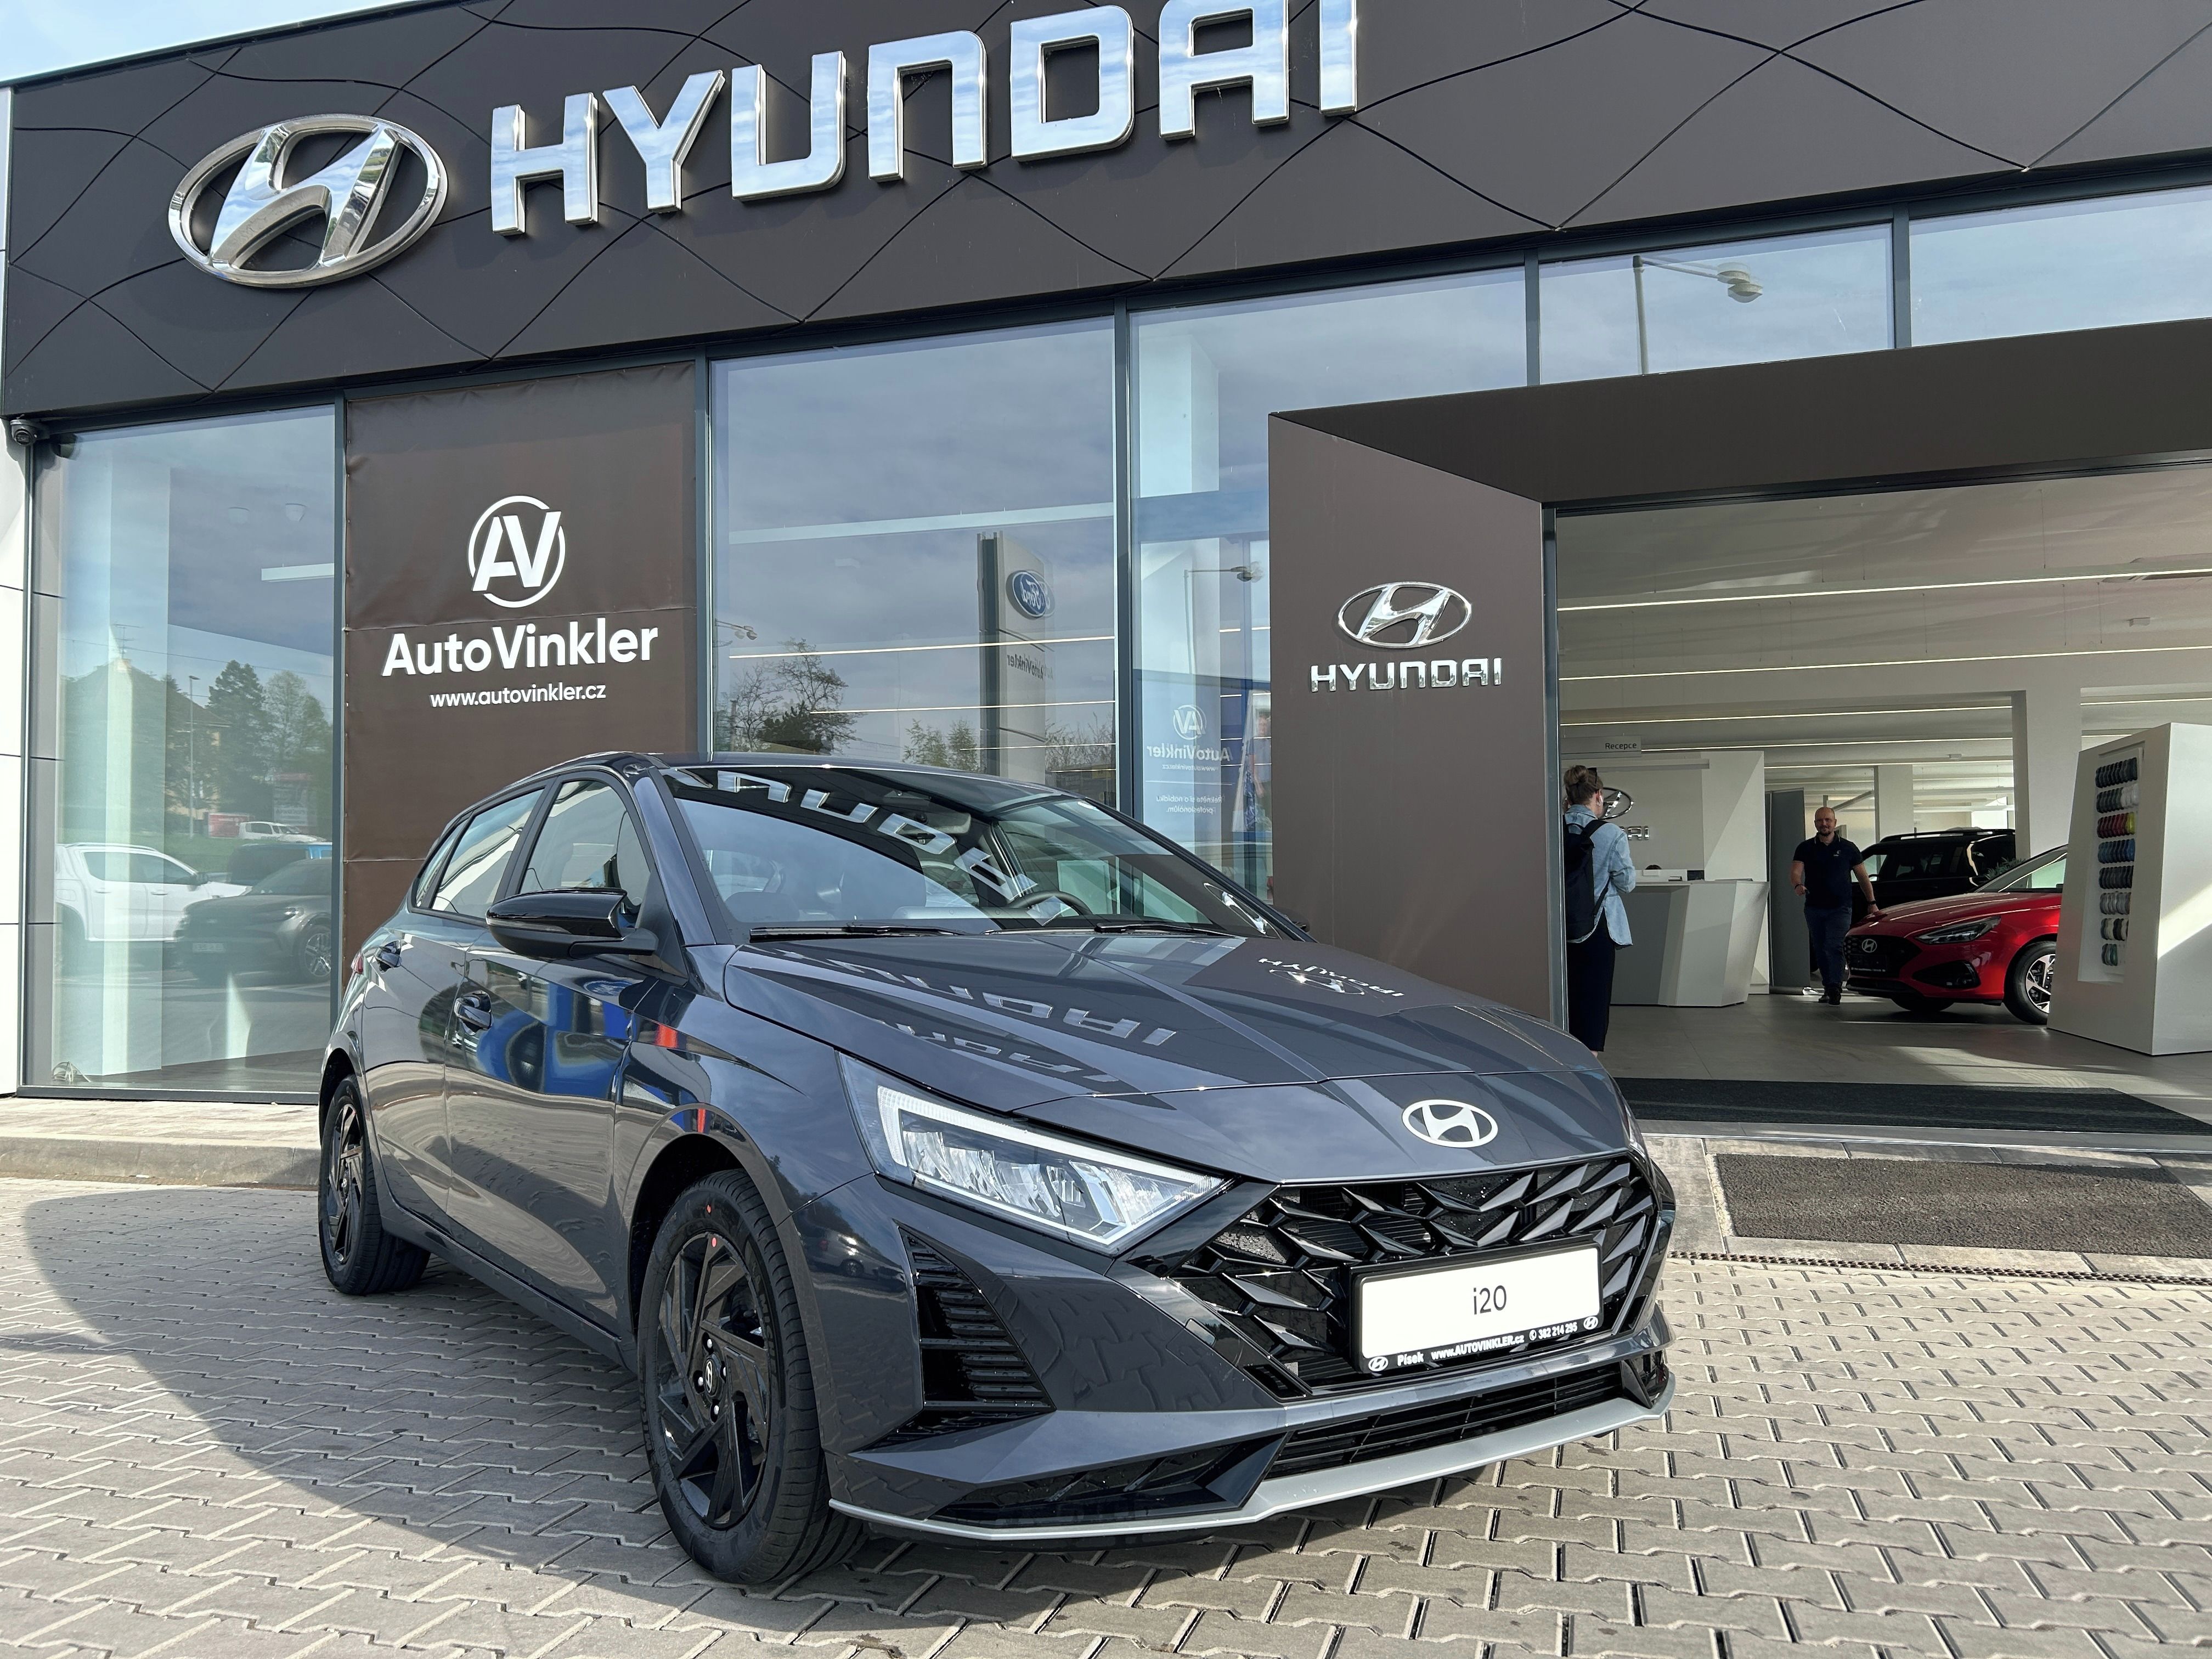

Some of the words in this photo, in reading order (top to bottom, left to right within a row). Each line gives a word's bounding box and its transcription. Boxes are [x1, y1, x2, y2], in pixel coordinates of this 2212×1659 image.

[490, 0, 1357, 236] HYUNDAI
[472, 511, 562, 592] AV
[382, 618, 658, 676] AutoVinkler
[1310, 658, 1502, 692] HYUNDAI
[431, 682, 606, 707] www.autovinkler.cz
[1605, 742, 1637, 751] Recepce
[1474, 1285, 1507, 1315] i20
[1431, 1335, 1525, 1360] www.AUTOVINKLER.cz
[1538, 1329, 1551, 1339] 382
[1552, 1326, 1565, 1336] 214
